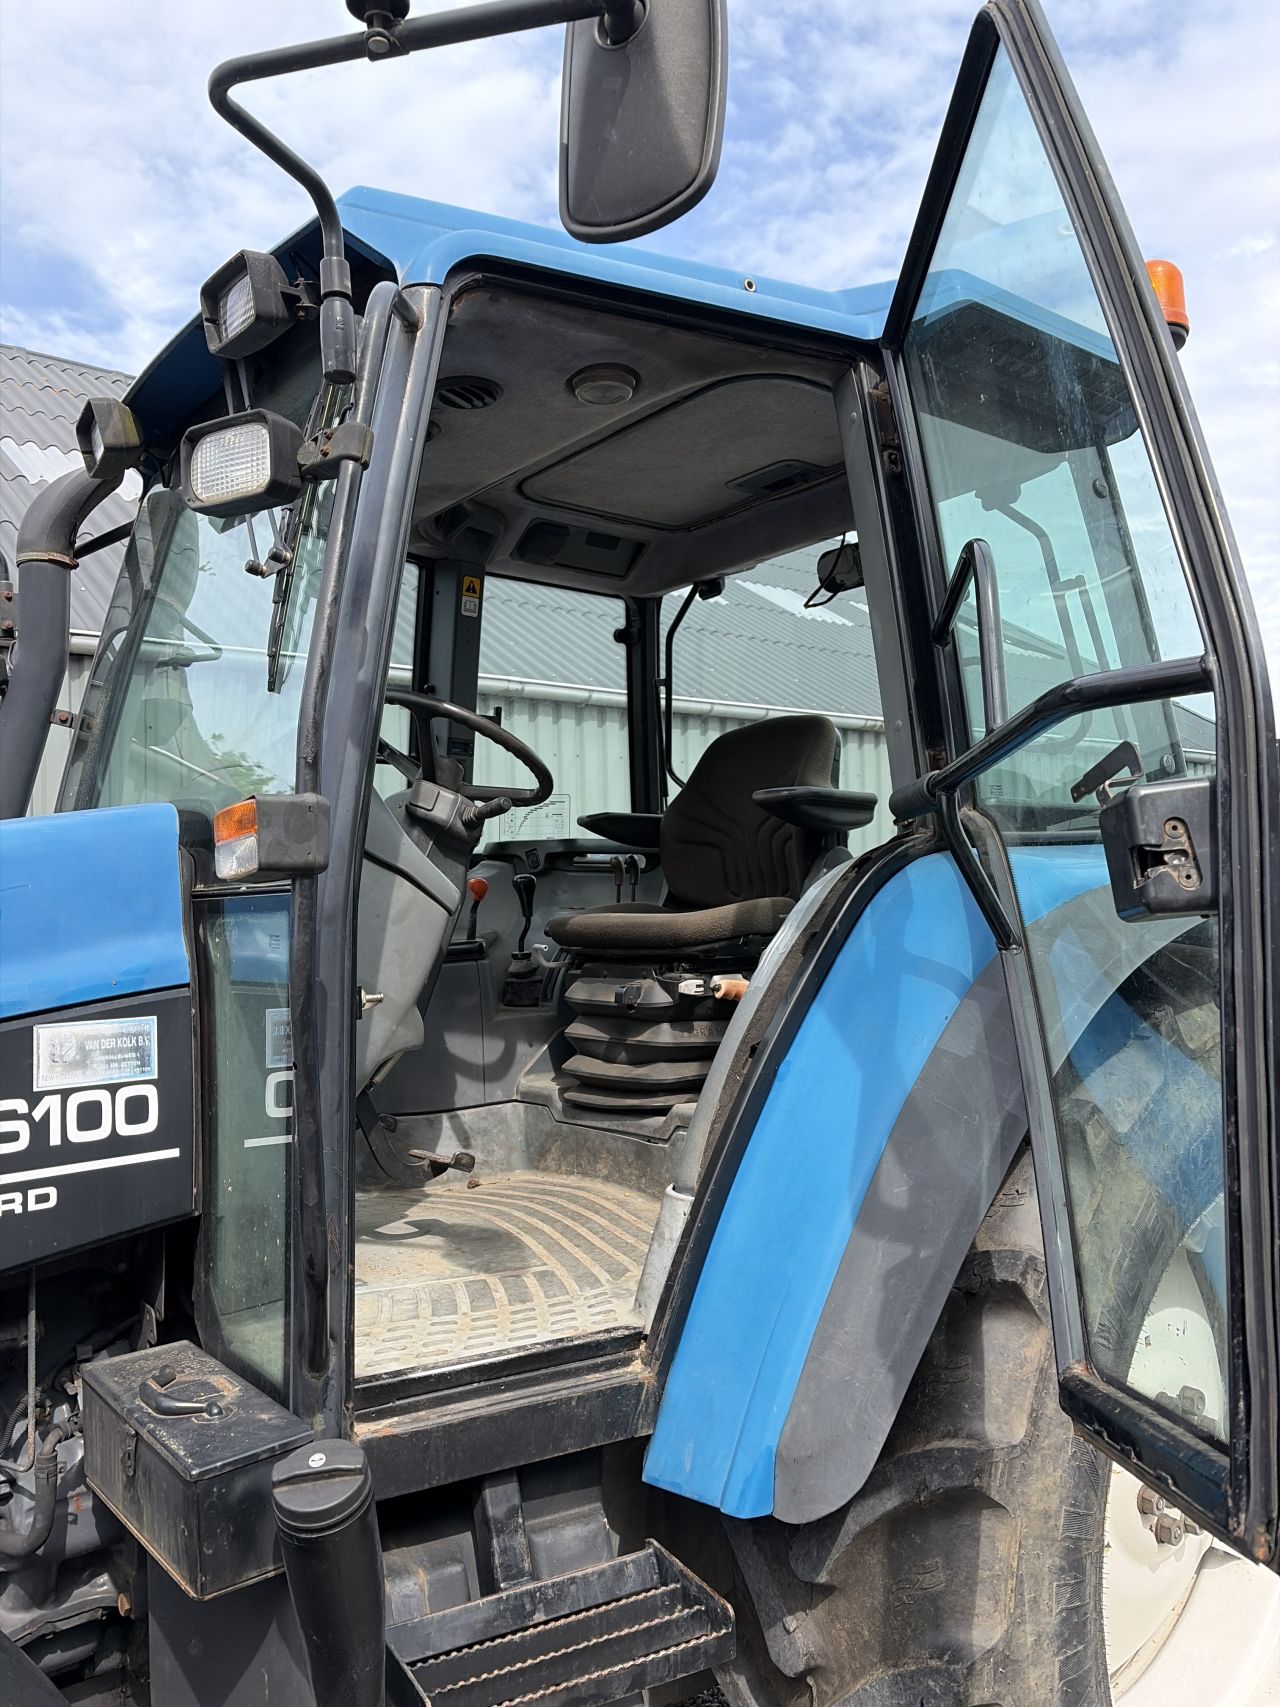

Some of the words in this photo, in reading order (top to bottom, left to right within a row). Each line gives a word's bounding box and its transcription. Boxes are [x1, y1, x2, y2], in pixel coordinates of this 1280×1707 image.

[84, 1039, 99, 1051] VAN
[101, 1037, 116, 1049] DER
[117, 1035, 137, 1048] KOLK
[0, 1084, 158, 1154] S100
[0, 1186, 57, 1217] RD
